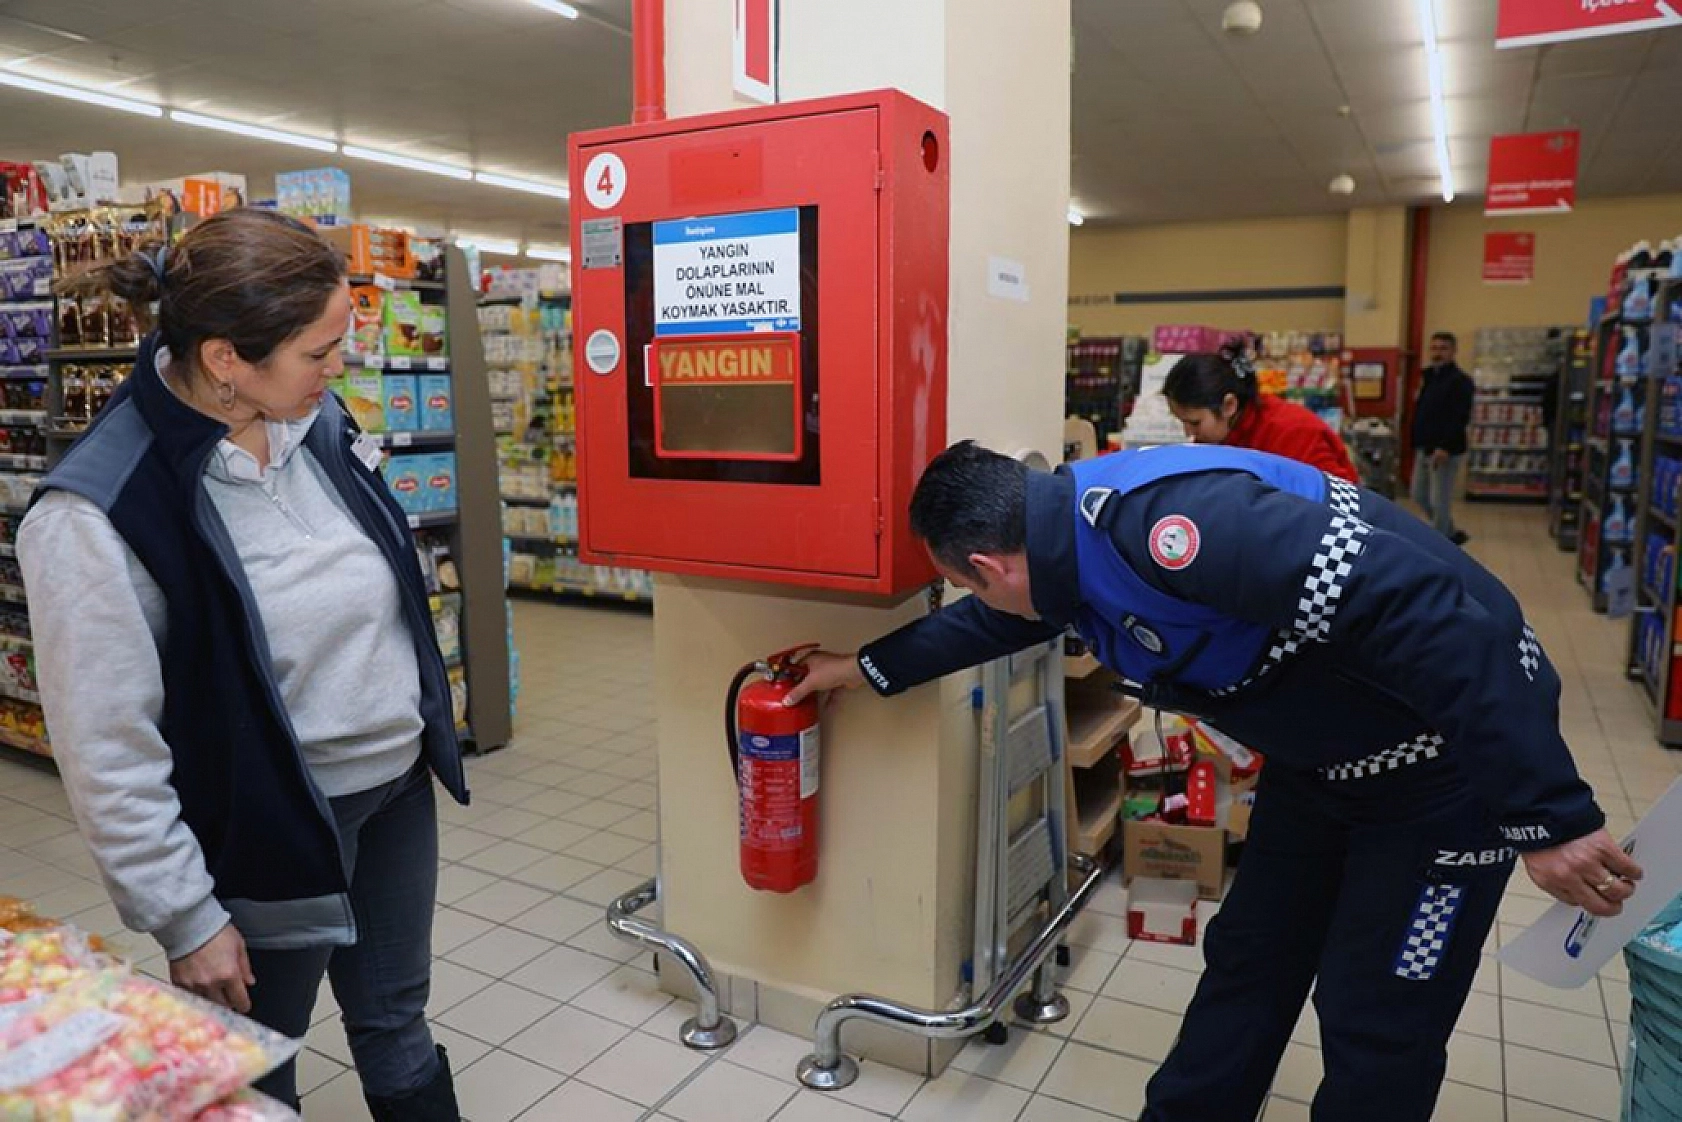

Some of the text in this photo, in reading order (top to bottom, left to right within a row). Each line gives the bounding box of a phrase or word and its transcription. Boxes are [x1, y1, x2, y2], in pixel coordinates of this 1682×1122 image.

[596, 165, 615, 196] 4
[699, 244, 749, 260] YANGIN
[675, 261, 775, 281] DOLAPLARININ
[685, 281, 764, 299] ÖNÜNE MAL
[661, 300, 793, 319] KOYMAK YASAKTIR.
[660, 347, 773, 379] YANGIN
[1434, 846, 1517, 866] ZABIT
